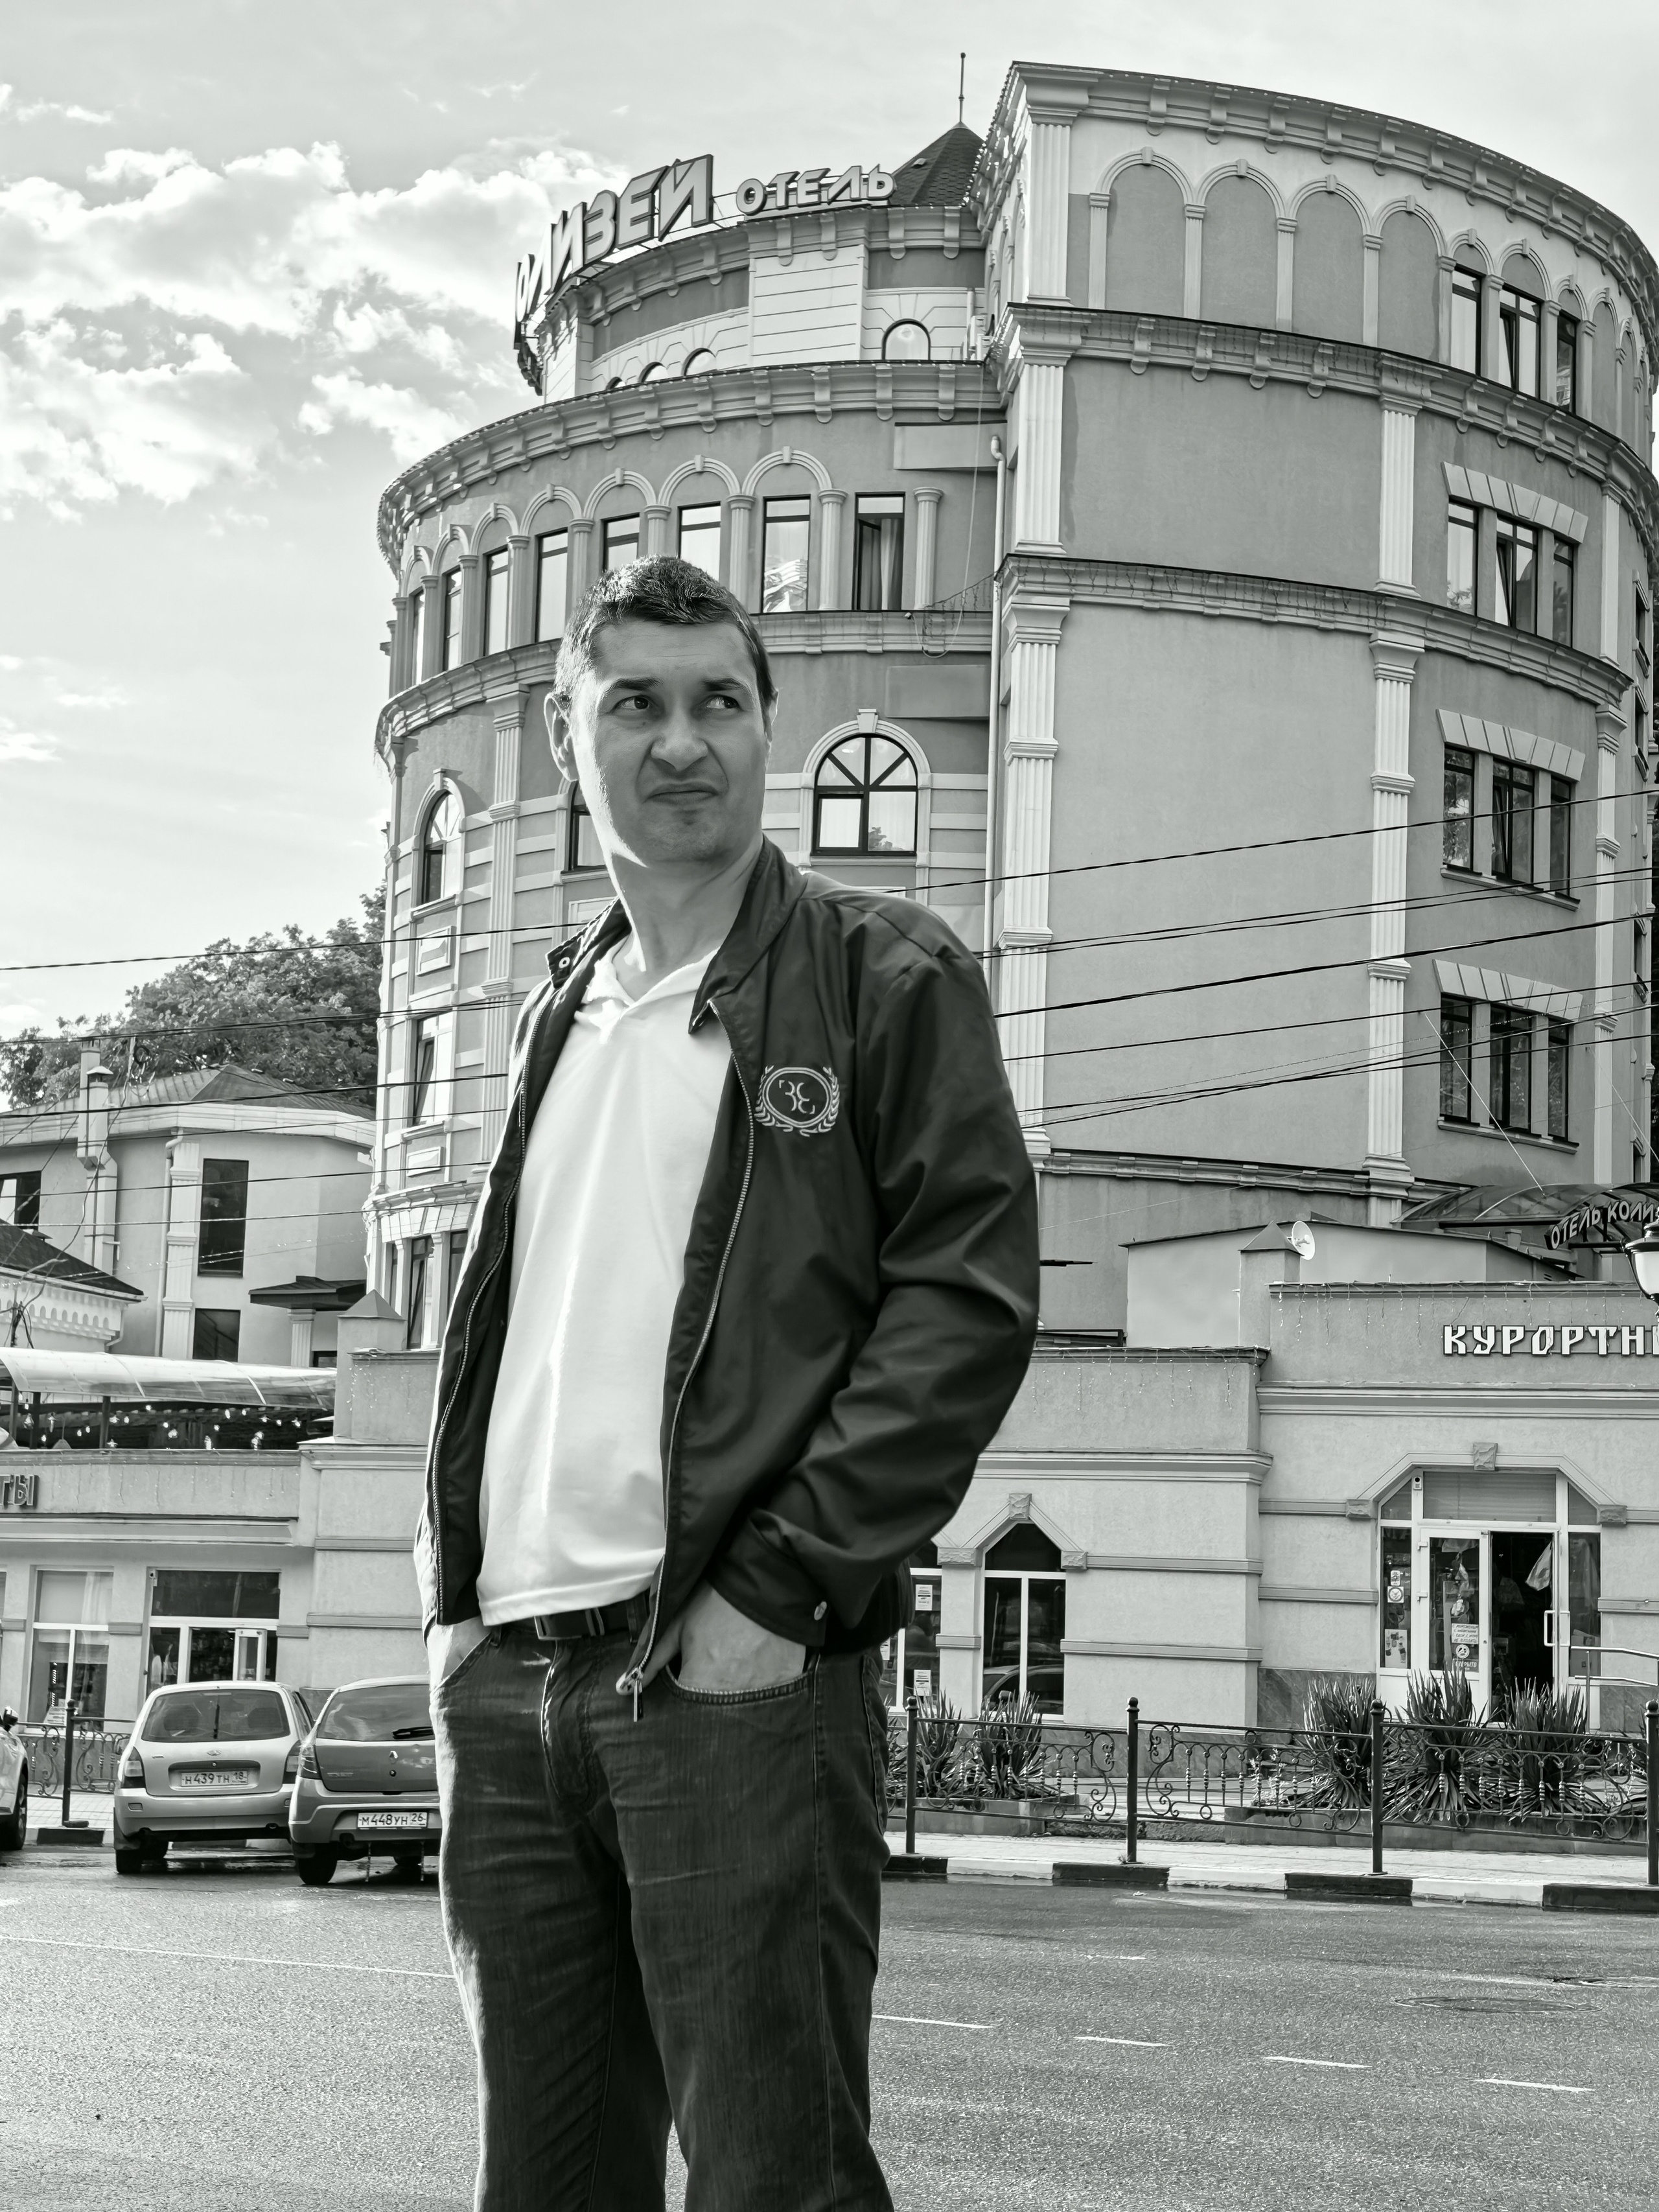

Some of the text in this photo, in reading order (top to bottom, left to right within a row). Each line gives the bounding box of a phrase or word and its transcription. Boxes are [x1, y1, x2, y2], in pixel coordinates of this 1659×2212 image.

[514, 154, 896, 349] ОЛИЗЕЙ ОТЕЛЬ
[1546, 1206, 1601, 1250] ОТЕЛЬ
